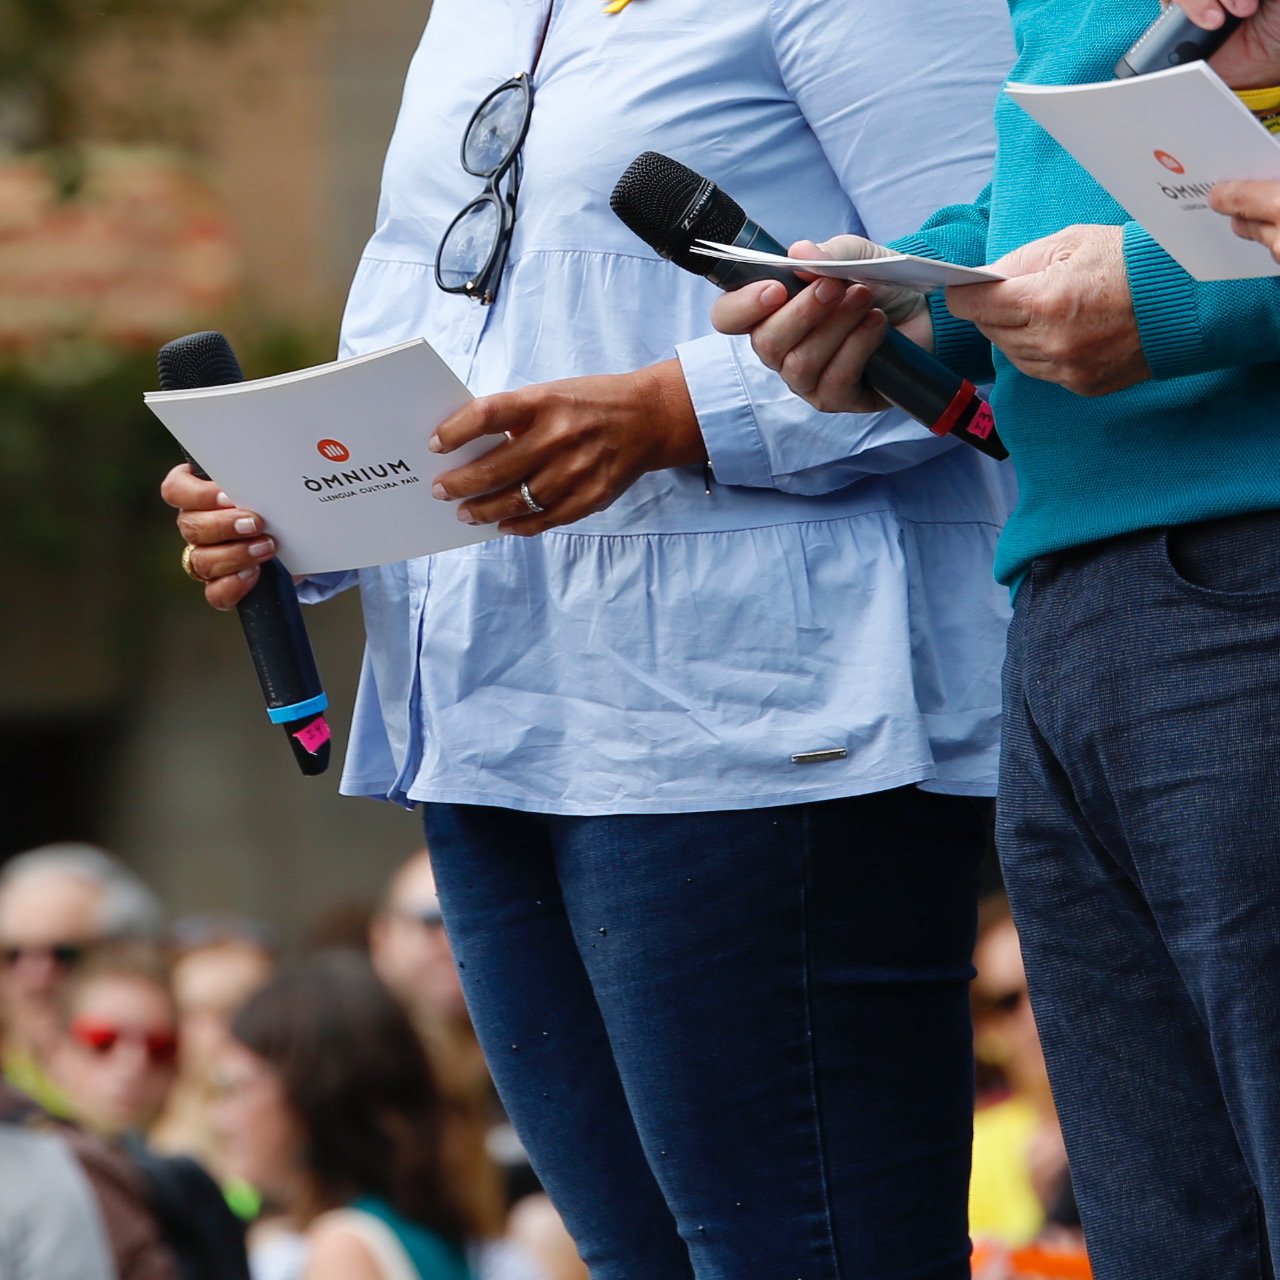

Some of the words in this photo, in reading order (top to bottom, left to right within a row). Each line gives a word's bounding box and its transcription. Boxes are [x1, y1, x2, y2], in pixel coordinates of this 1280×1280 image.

[302, 458, 411, 492] ÒMNIUM
[318, 490, 358, 503] LLENGUA
[359, 480, 399, 495] CULTURA
